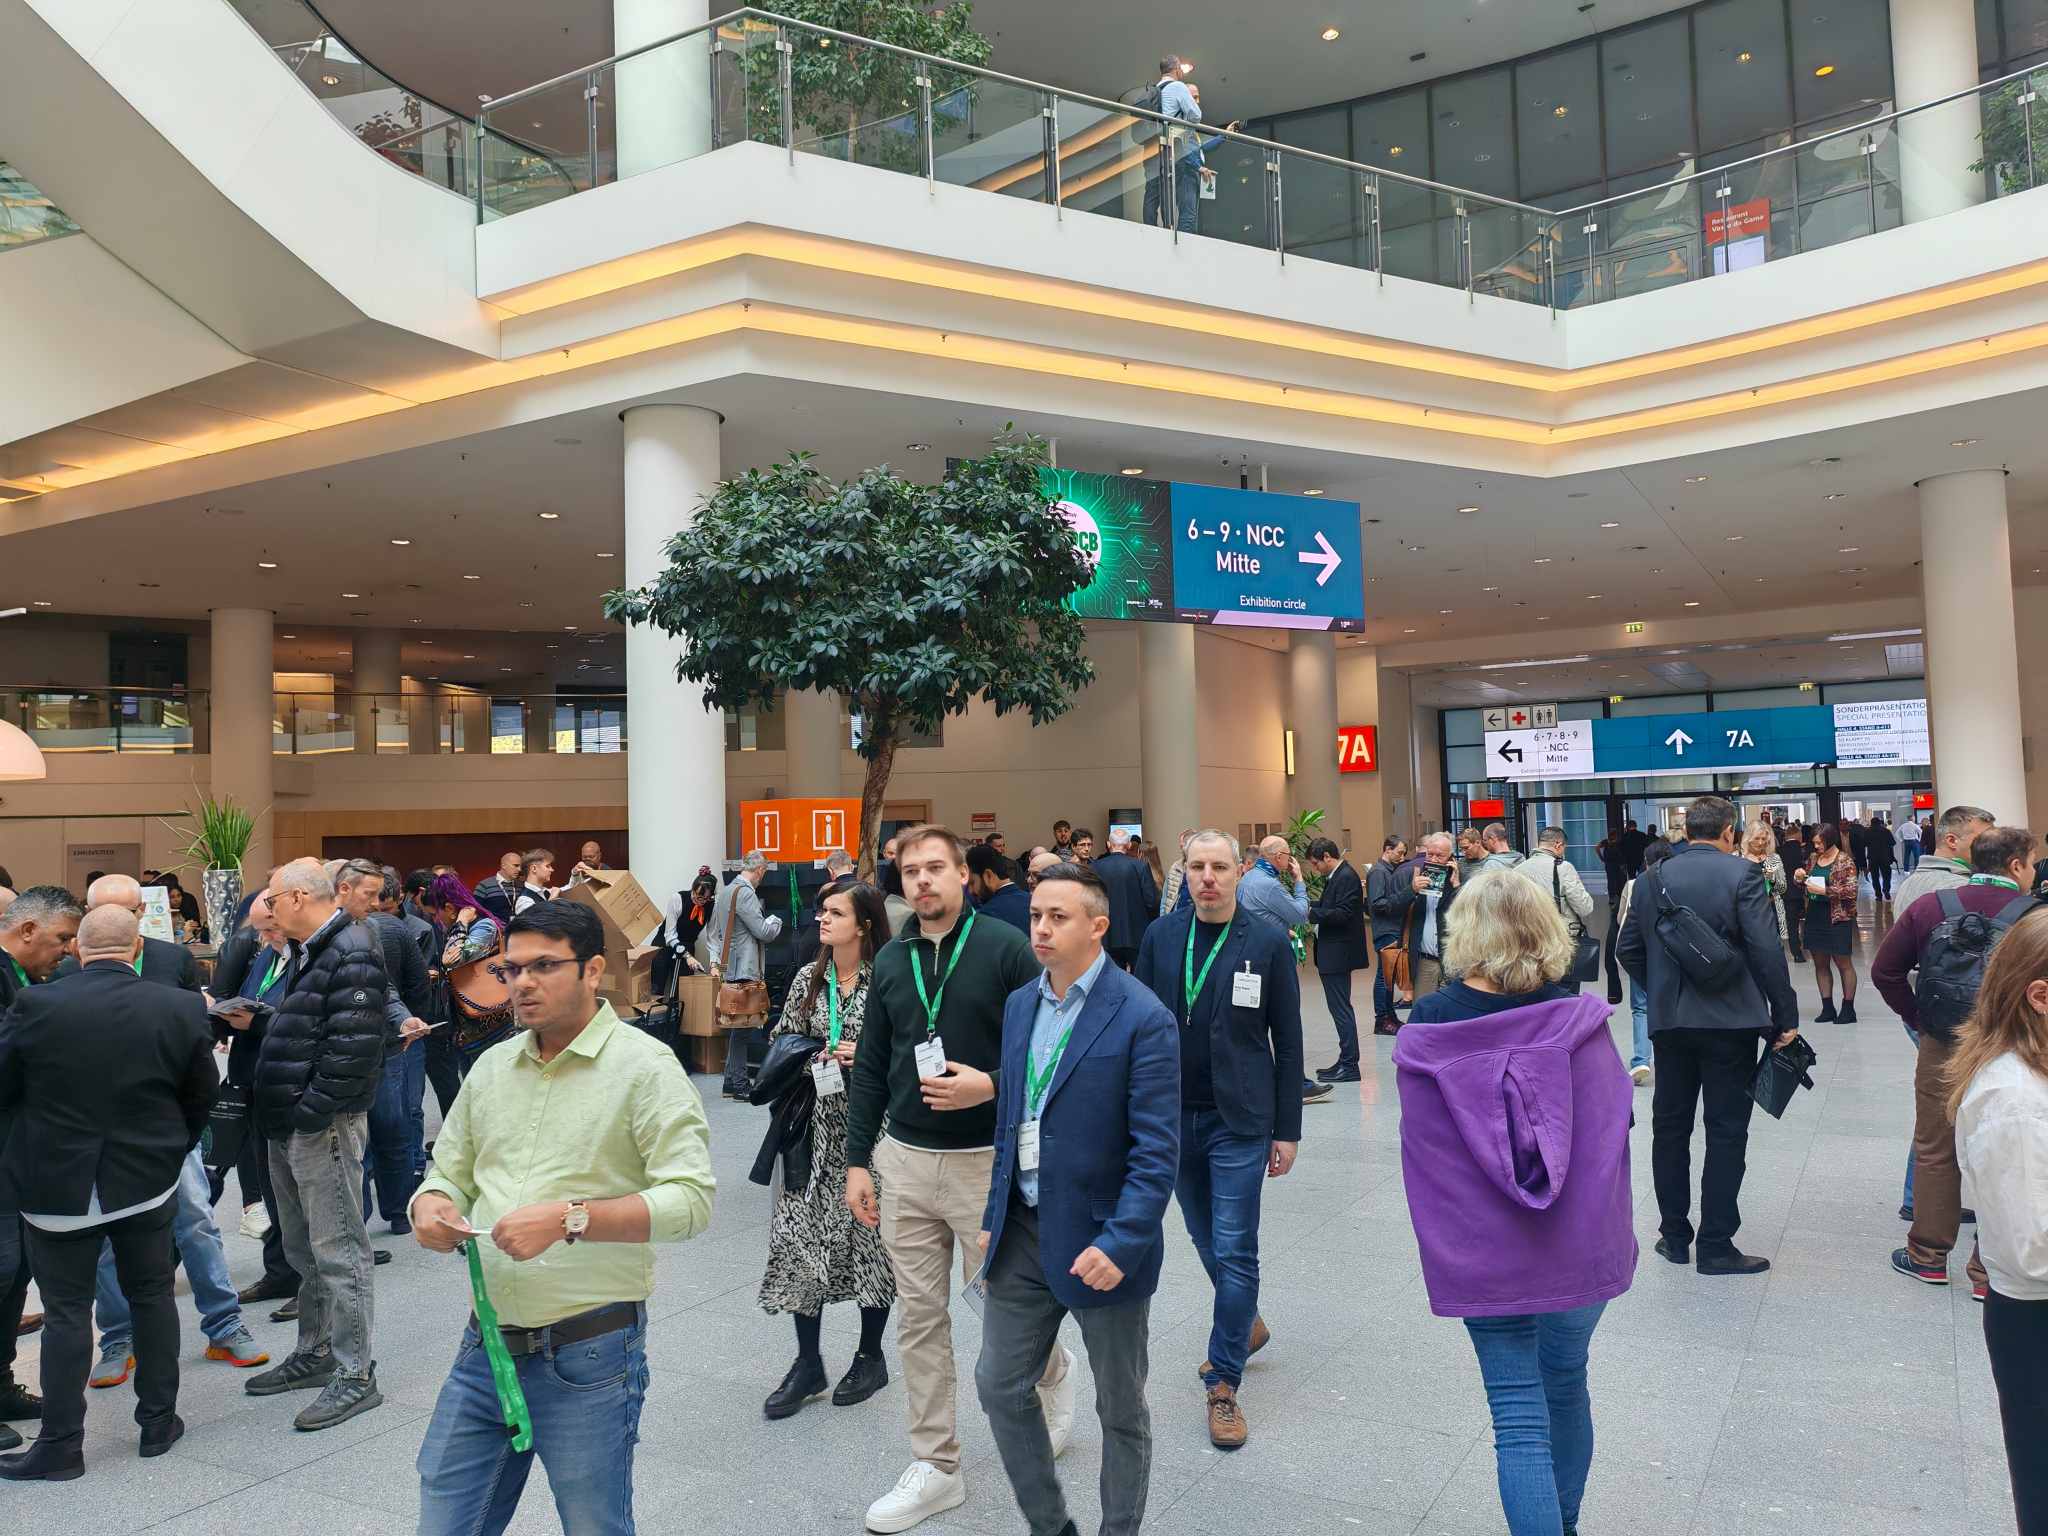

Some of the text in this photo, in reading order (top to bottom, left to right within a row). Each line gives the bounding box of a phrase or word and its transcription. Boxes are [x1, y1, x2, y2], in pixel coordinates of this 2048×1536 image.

[1247, 523, 1284, 547] NCC
[1216, 550, 1260, 575] Mitte
[1240, 595, 1306, 610] Exhibition circle
[1549, 743, 1569, 751] NCC
[1726, 730, 1754, 747] 7A
[1337, 734, 1371, 764] 7A
